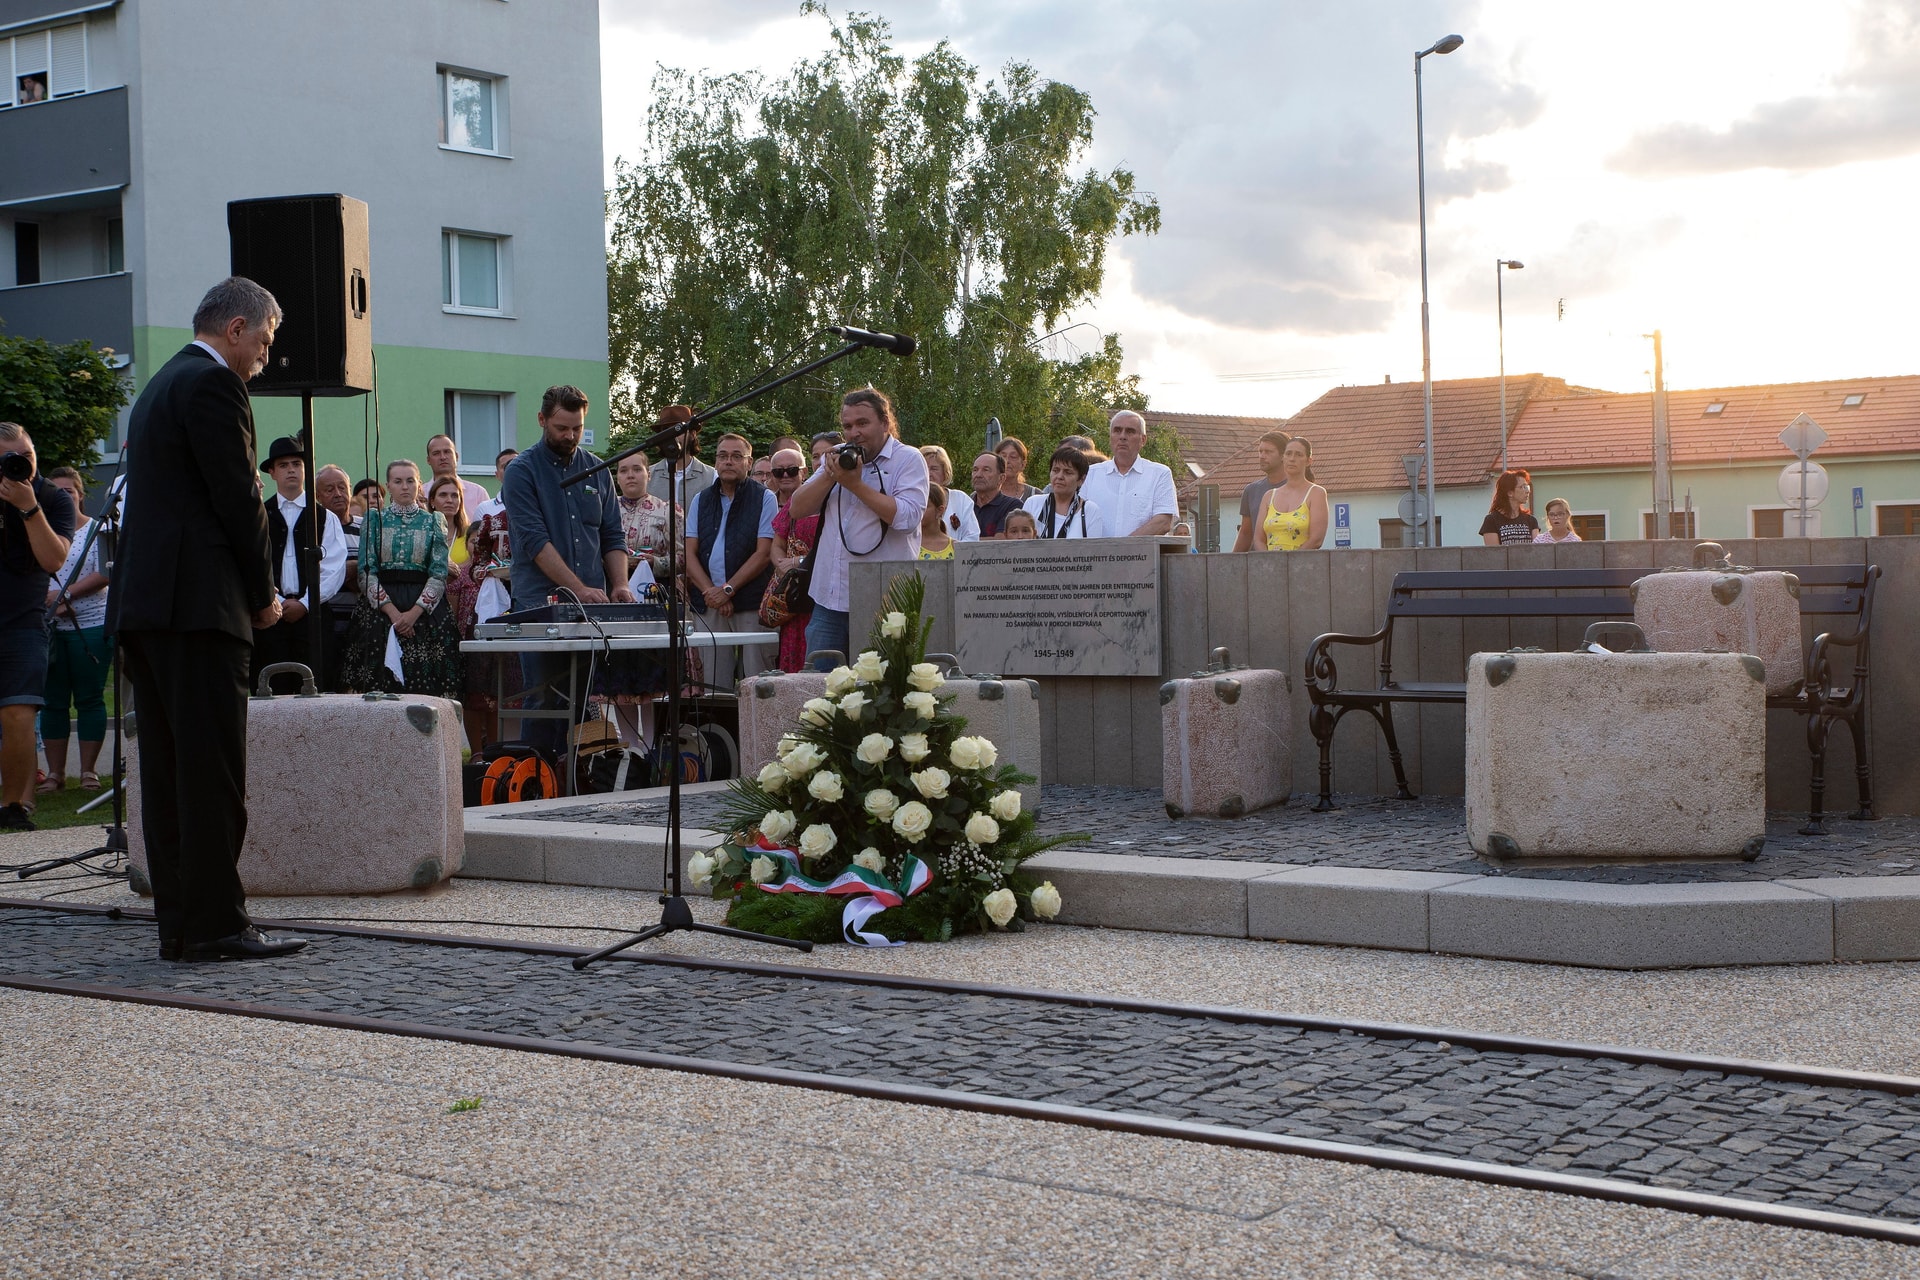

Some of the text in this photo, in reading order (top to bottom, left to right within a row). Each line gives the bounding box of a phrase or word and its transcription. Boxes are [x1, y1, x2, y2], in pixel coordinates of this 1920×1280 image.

[1338, 506, 1345, 520] P
[1117, 554, 1147, 562] DEPORTÁLT
[1036, 565, 1065, 573] CSALÁDOK
